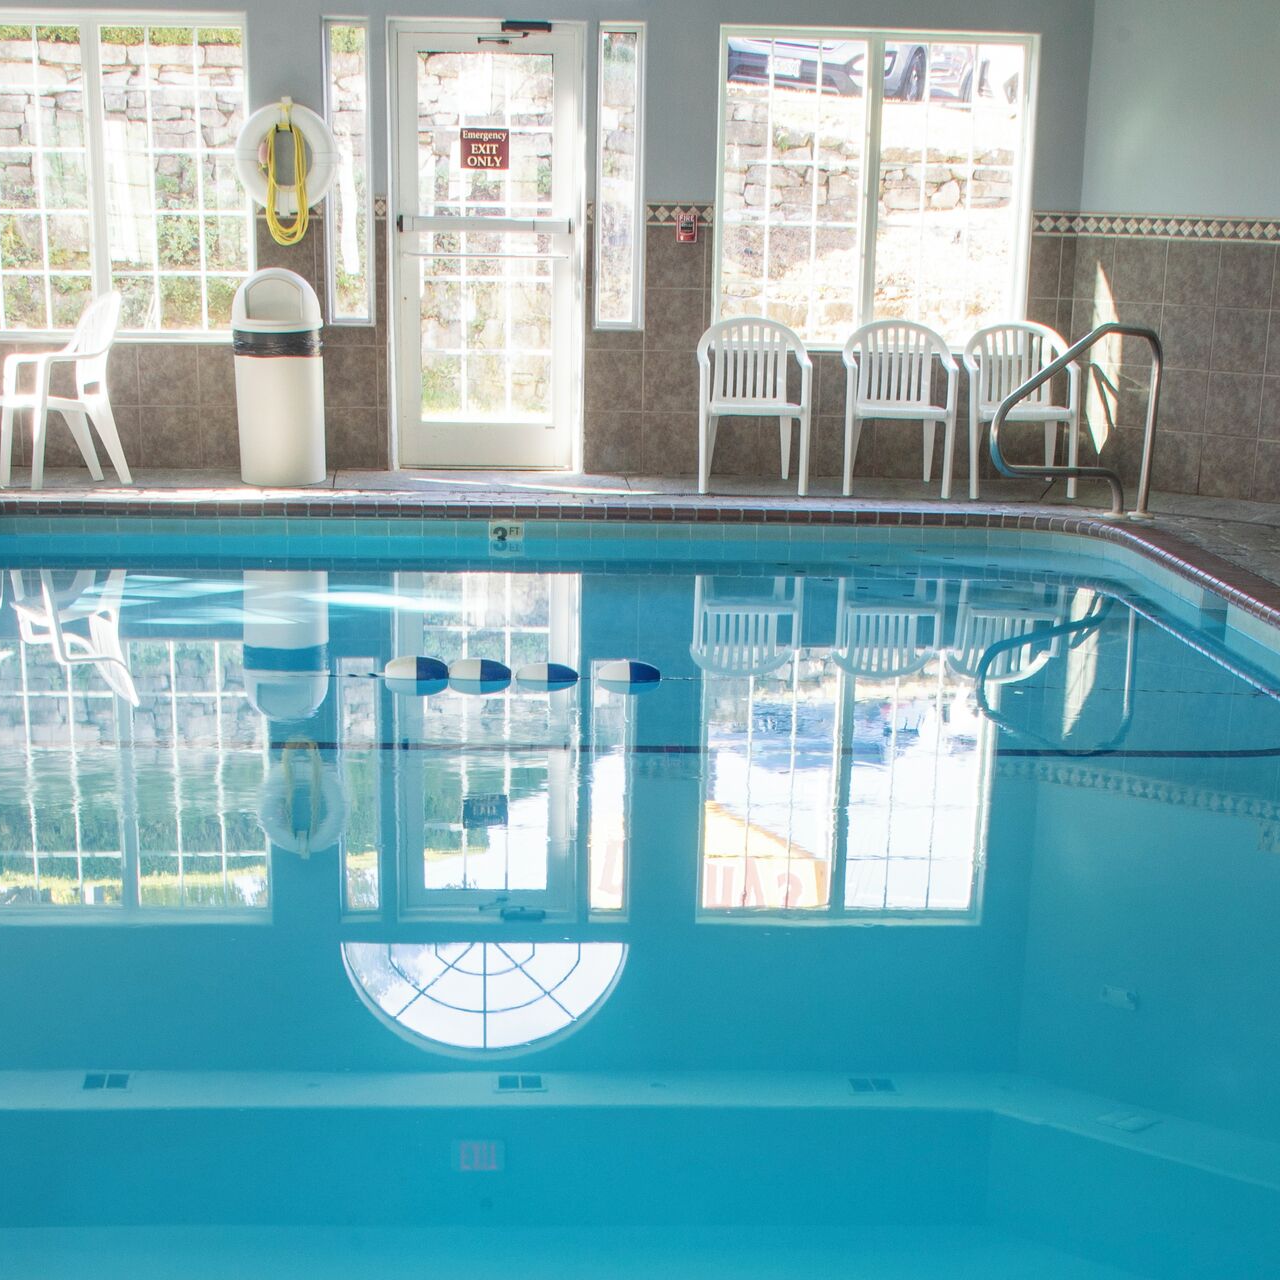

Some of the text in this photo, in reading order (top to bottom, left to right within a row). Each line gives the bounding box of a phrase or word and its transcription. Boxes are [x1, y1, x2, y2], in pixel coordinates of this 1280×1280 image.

[462, 130, 507, 142] Emergency
[471, 144, 499, 155] EXIT
[467, 156, 502, 167] ONLY
